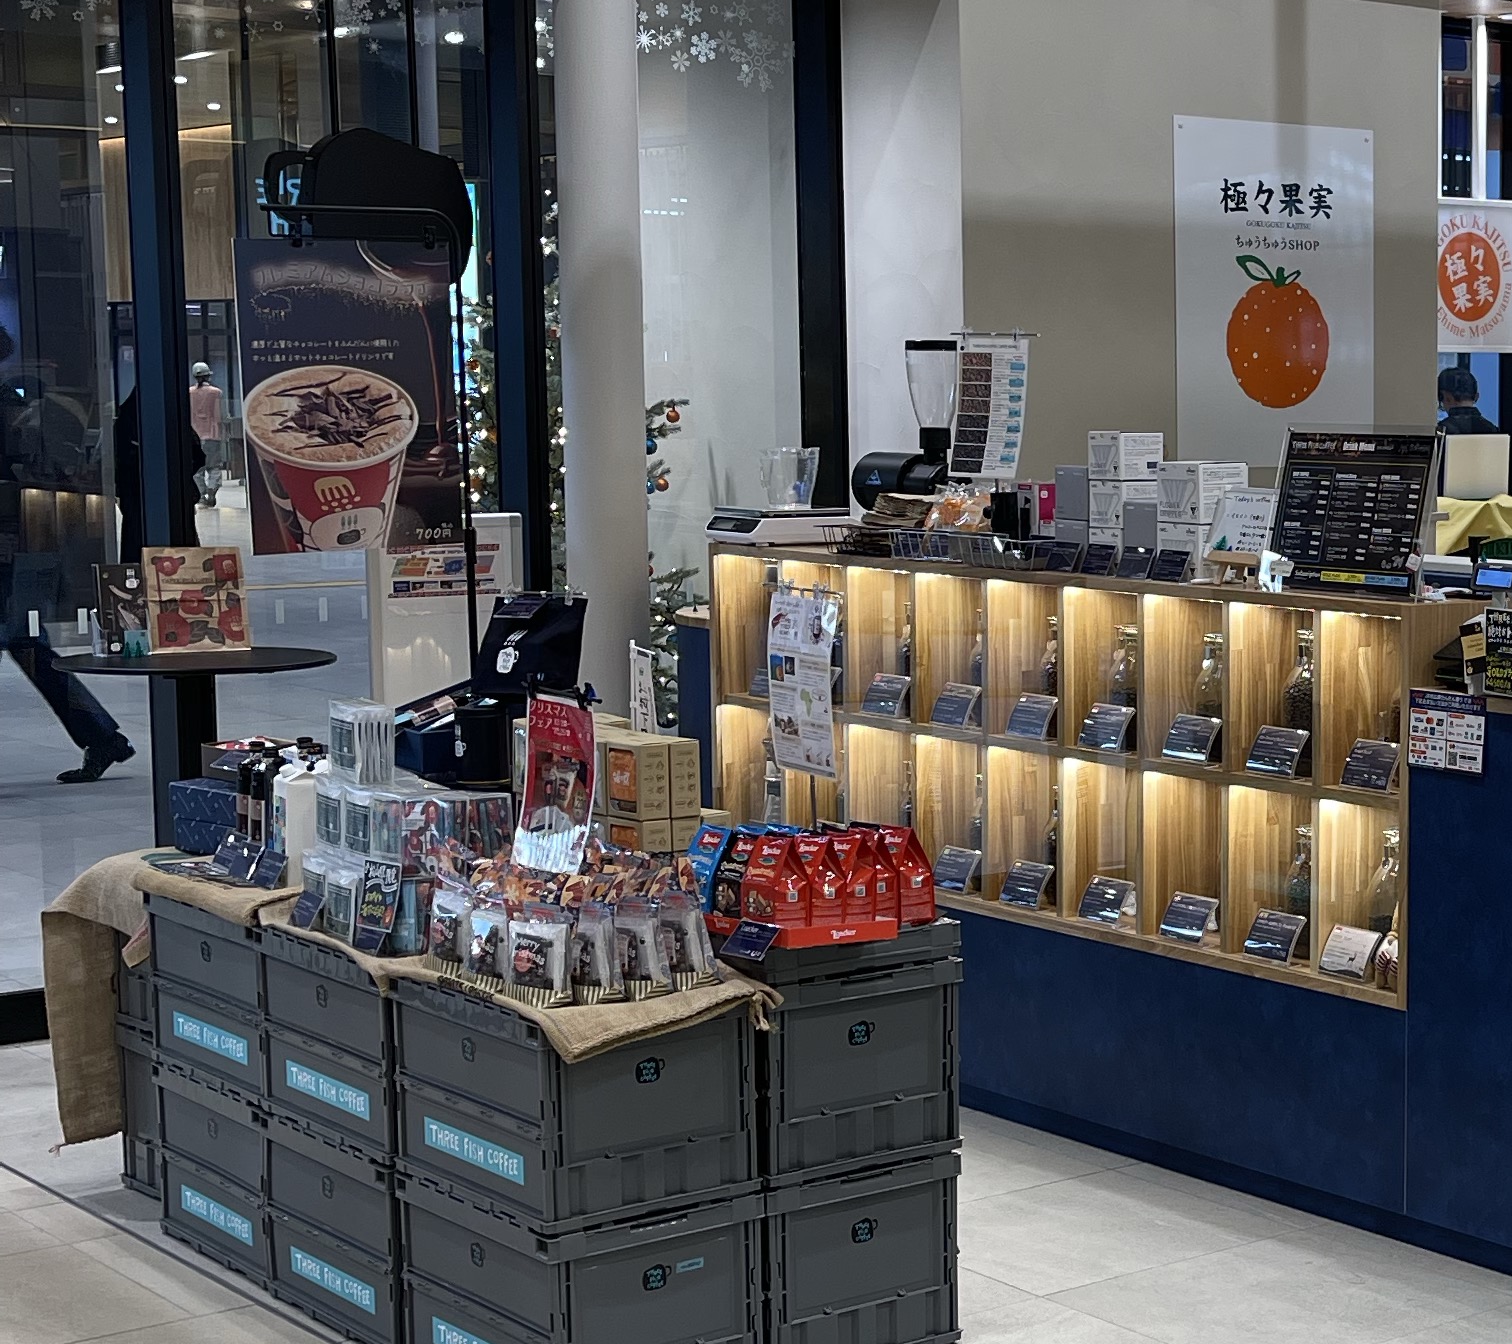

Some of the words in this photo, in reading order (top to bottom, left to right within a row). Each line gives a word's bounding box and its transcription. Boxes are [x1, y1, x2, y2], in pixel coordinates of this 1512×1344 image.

[1219, 177, 1334, 220] 極々果実
[1235, 234, 1321, 251] ちゅうちゅうSHOP
[1472, 213, 1512, 273] KAJITSU
[1437, 306, 1466, 338] Ehime
[1469, 282, 1512, 339] Matsuyama
[415, 527, 452, 540] 700円
[529, 714, 553, 730] フェア
[530, 699, 568, 718] クリスマス
[830, 927, 857, 940] Loacker
[177, 1017, 201, 1040] THREE
[203, 1027, 219, 1048] FISH
[221, 1035, 244, 1058] COFFEE
[290, 1067, 316, 1092] THREE
[319, 1078, 336, 1100] FISH
[339, 1088, 365, 1112] COFFEE
[429, 1124, 459, 1152] THREE
[463, 1136, 484, 1164] FISH
[487, 1148, 519, 1176] COFFEE
[185, 1190, 207, 1216] THREE
[209, 1203, 225, 1226] FISH
[226, 1213, 249, 1239] COFFEE
[295, 1252, 321, 1281] THREE
[324, 1265, 342, 1290] FISH
[343, 1278, 371, 1306] COFFEE
